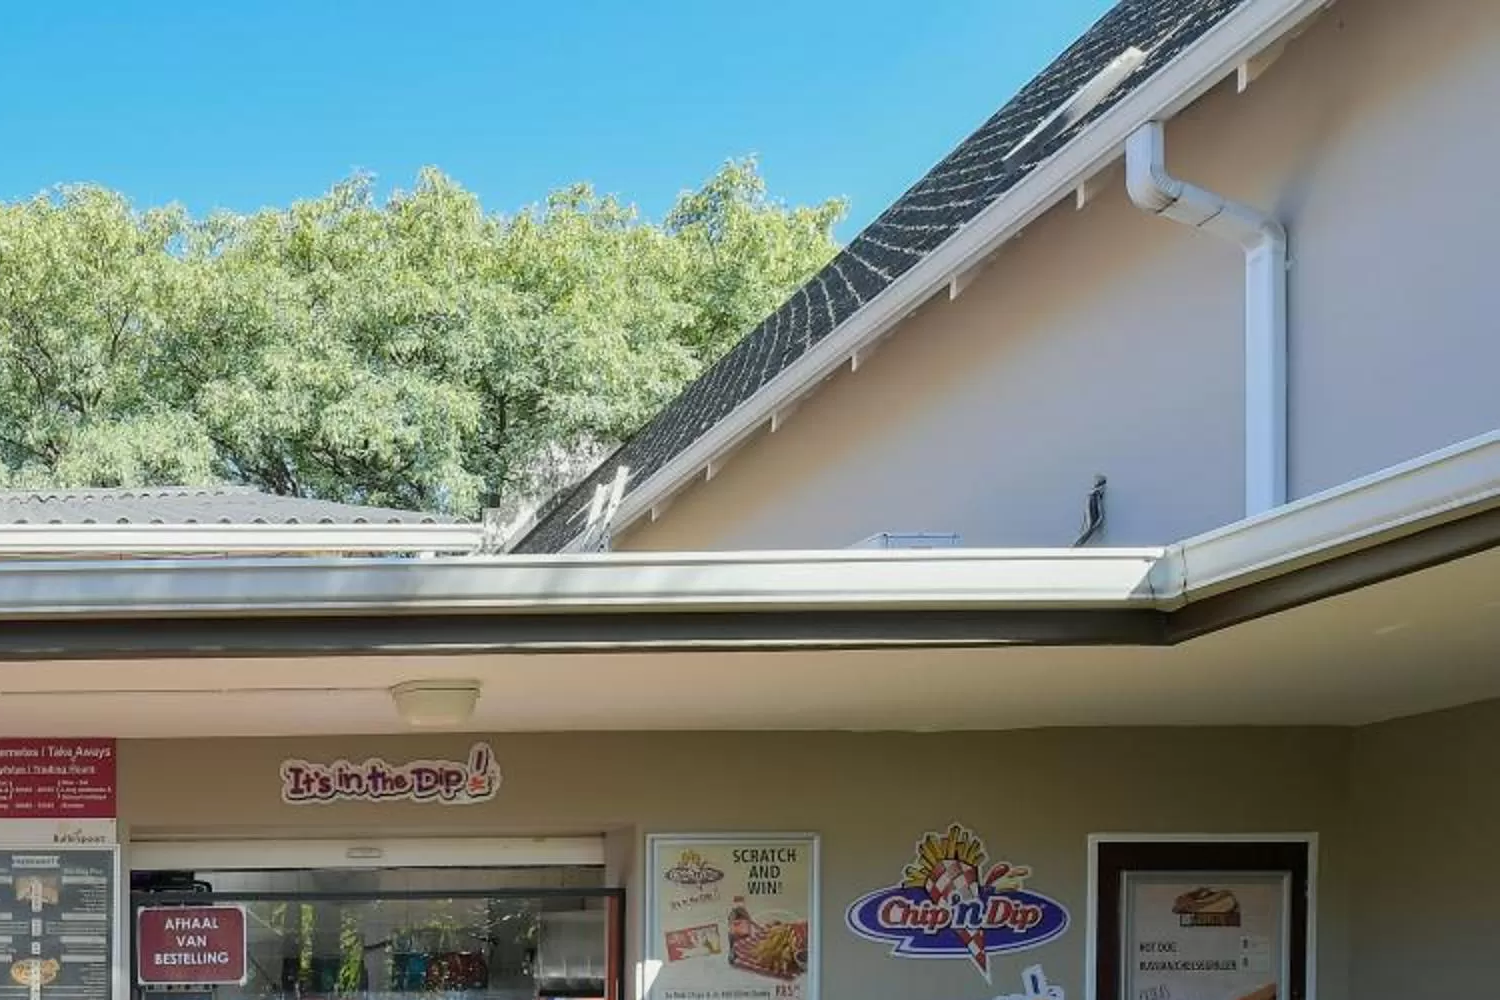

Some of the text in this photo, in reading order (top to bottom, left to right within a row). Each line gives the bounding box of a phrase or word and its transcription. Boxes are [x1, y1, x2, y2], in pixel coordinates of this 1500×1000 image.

[289, 767, 331, 794] It's
[338, 767, 363, 790] in
[367, 766, 407, 792] the
[732, 848, 796, 862] SCRATCH
[749, 866, 781, 879] AND
[748, 881, 782, 894] WIN!
[881, 899, 949, 931] Chip
[987, 899, 1040, 930] Dip
[165, 917, 219, 930] AFHAAL
[176, 935, 207, 947] VAN
[154, 951, 229, 965] BESTELLING
